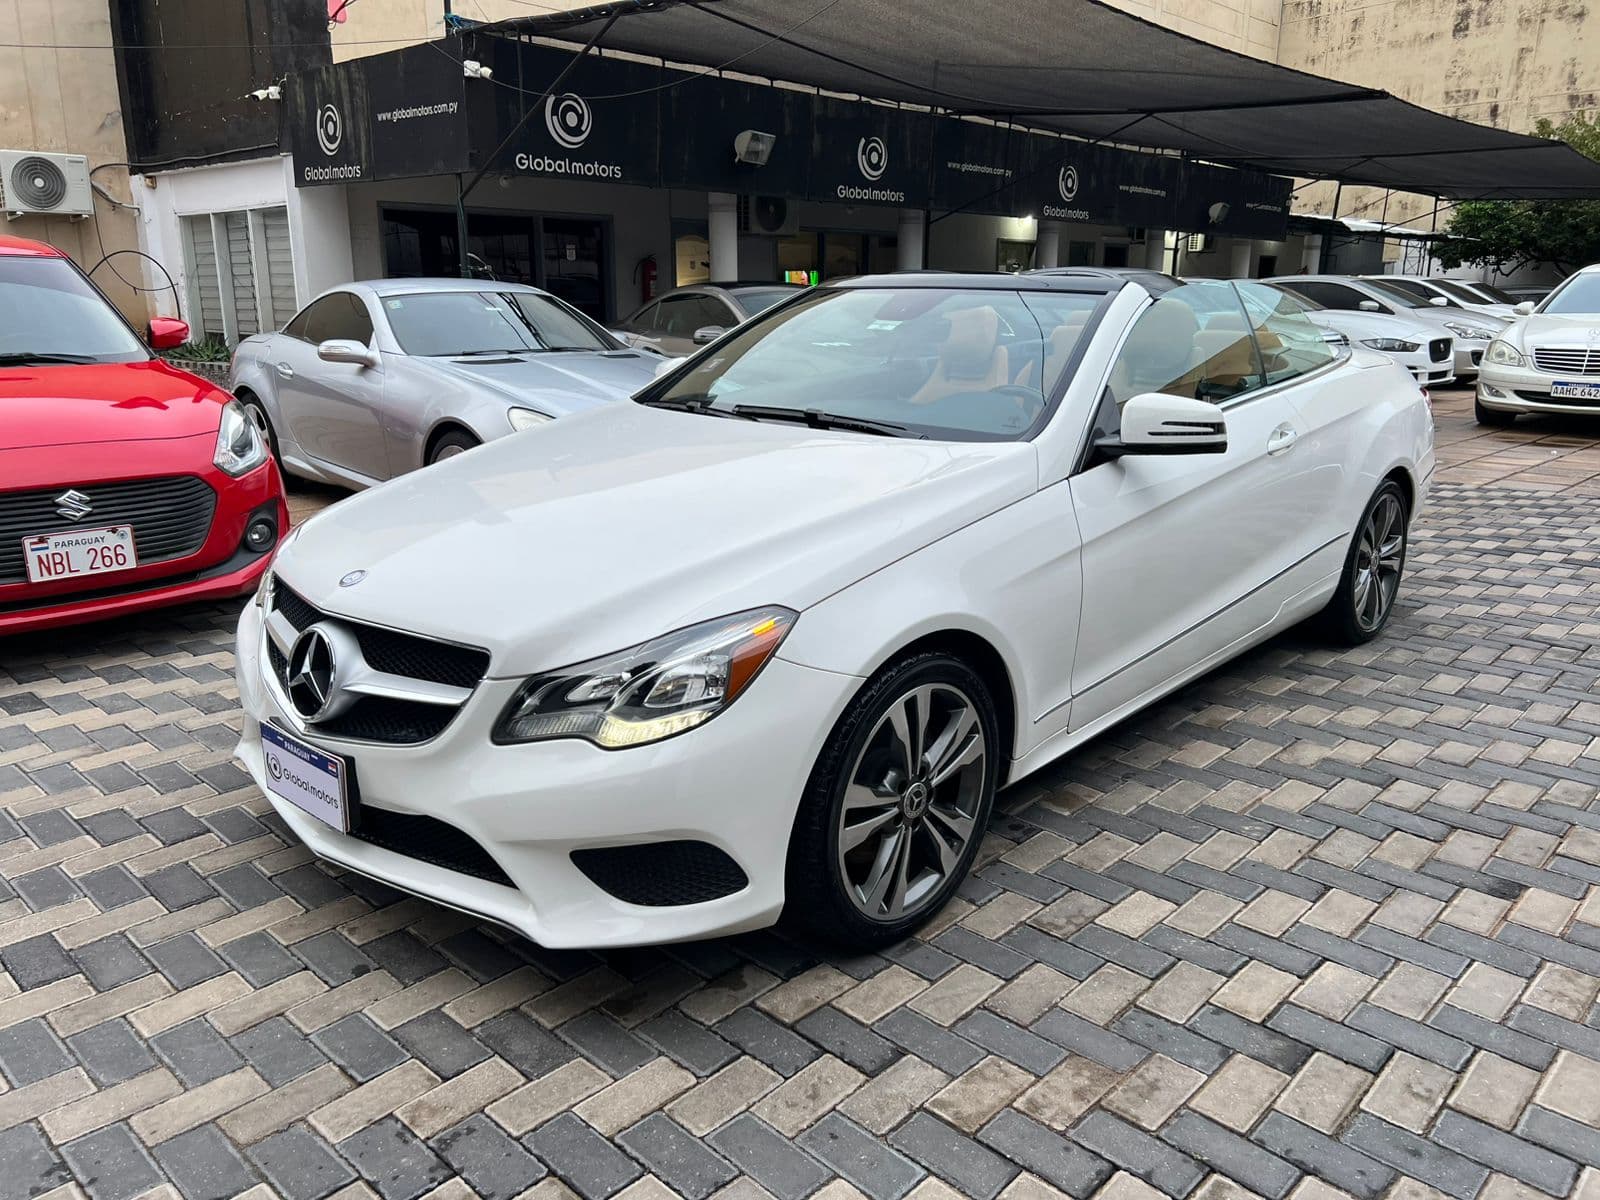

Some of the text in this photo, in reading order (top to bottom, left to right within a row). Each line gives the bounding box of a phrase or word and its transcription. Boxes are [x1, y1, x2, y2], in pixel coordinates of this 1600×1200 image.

[377, 102, 458, 122] www.globalmotors.com.py
[304, 165, 361, 181] Globalmotors
[515, 153, 622, 178] Globalmotors
[837, 185, 905, 202] Globalmotors
[1043, 205, 1089, 220] Globalmotors
[1553, 386, 1578, 396] AAHC
[54, 536, 106, 549] PARAGUAY
[37, 544, 127, 577] NBL 266
[284, 741, 310, 761] PARAGUAY
[283, 768, 339, 809] Globalmotors
